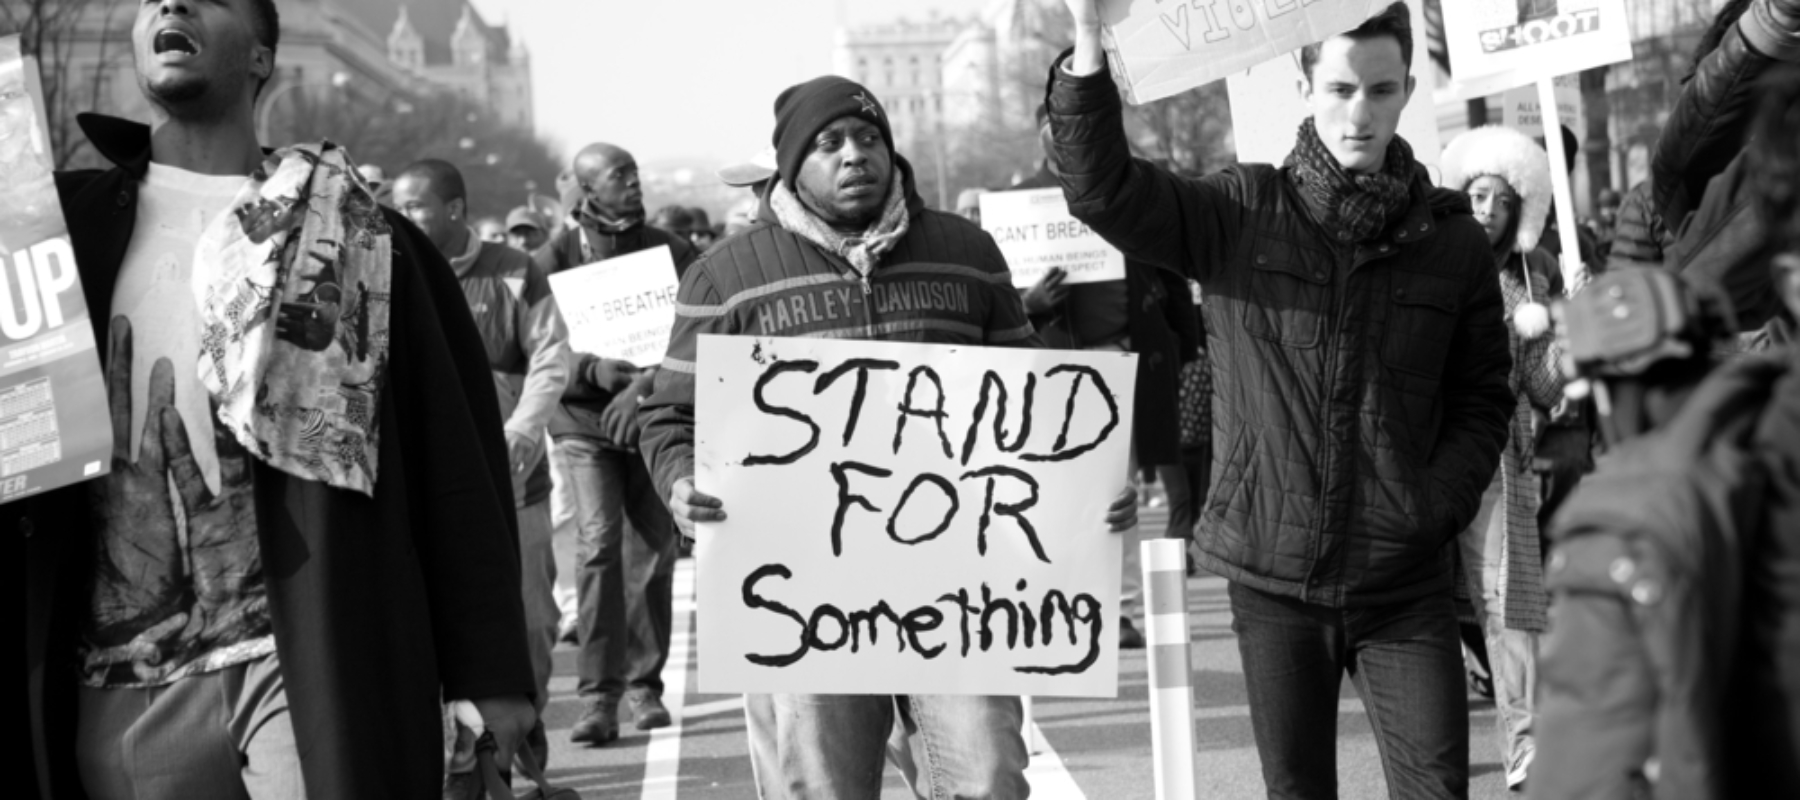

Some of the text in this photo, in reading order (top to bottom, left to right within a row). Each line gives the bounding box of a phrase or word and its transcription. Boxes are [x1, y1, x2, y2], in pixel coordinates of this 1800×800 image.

[1480, 9, 1599, 52] SHOOT
[993, 220, 1094, 243] CAN'T BREA
[1023, 253, 1063, 264] HUMAN
[1066, 249, 1107, 261] BEINGS
[1062, 260, 1106, 273] ESPECT
[0, 237, 77, 340] UP
[602, 284, 676, 322] BREATHE
[621, 338, 668, 358] RESPEC
[742, 358, 1119, 466] STAND
[830, 460, 1052, 563] FOR
[742, 563, 1101, 675] Something
